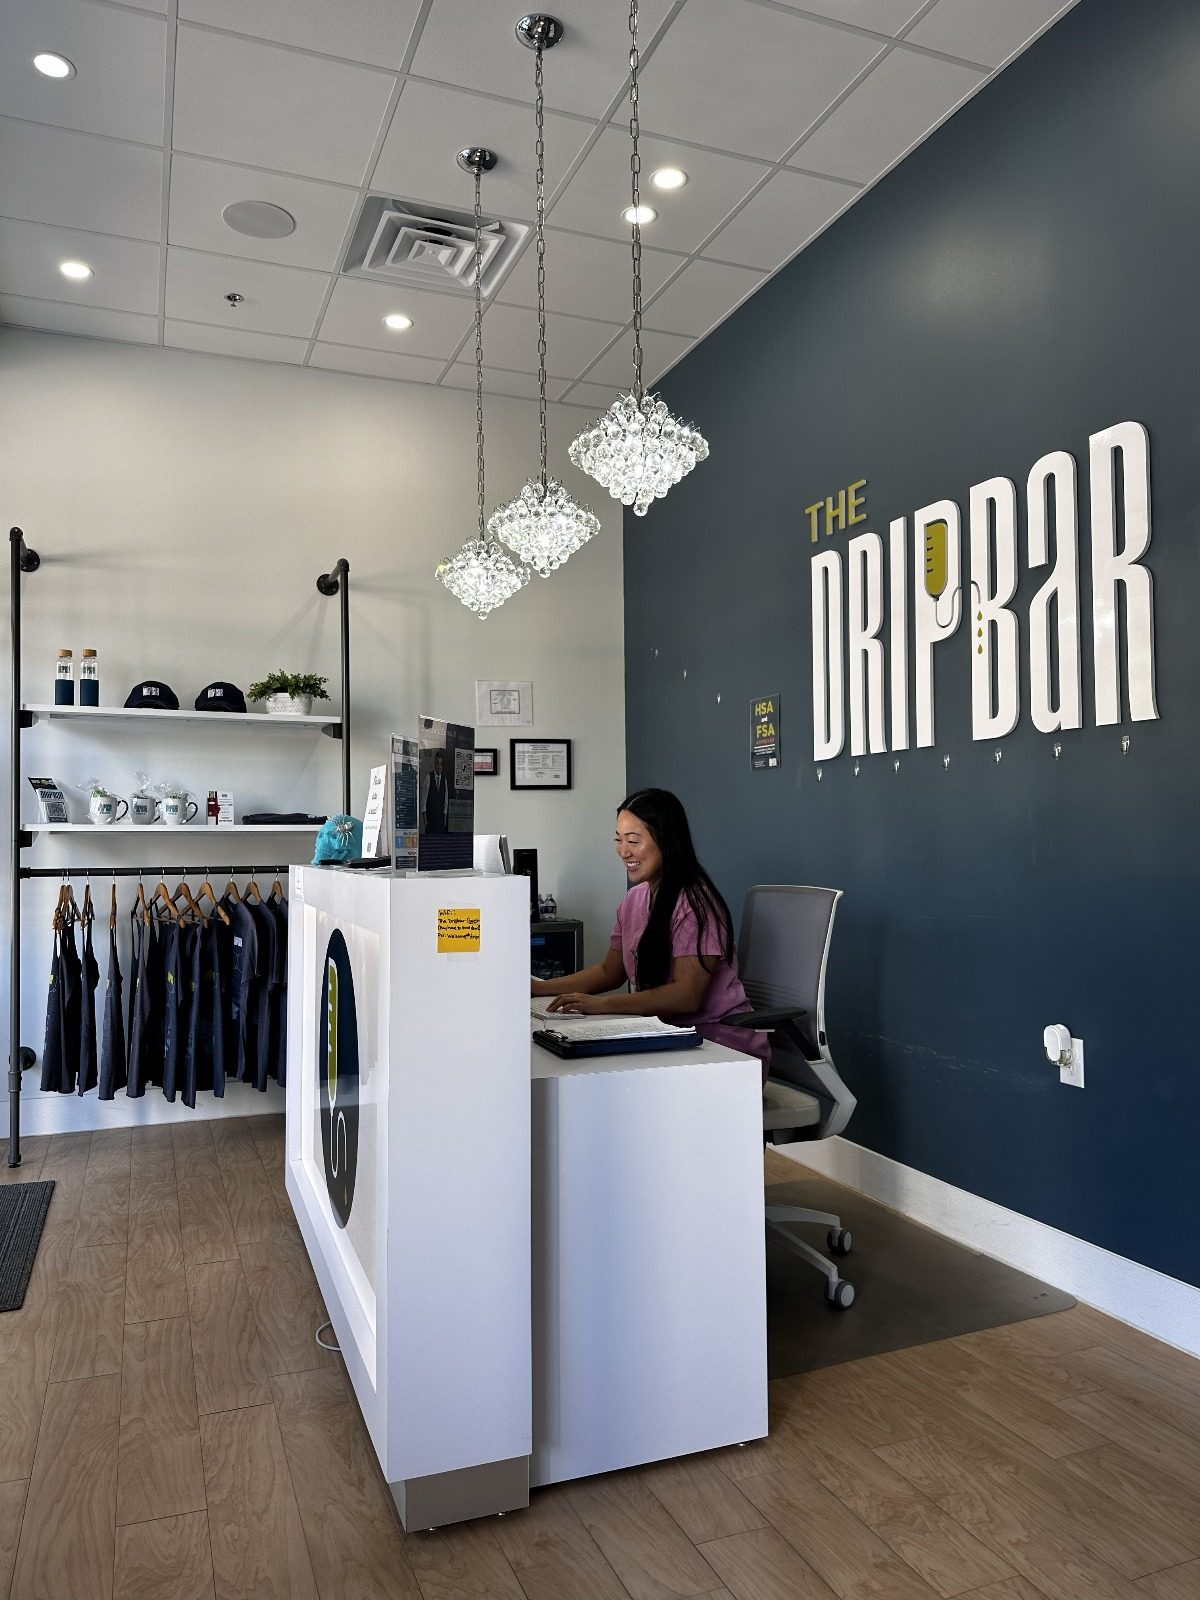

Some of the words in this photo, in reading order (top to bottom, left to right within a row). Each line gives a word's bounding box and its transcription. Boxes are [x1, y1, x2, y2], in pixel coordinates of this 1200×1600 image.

[805, 479, 867, 544] THE
[755, 700, 773, 717] HSA
[756, 723, 775, 738] FSA
